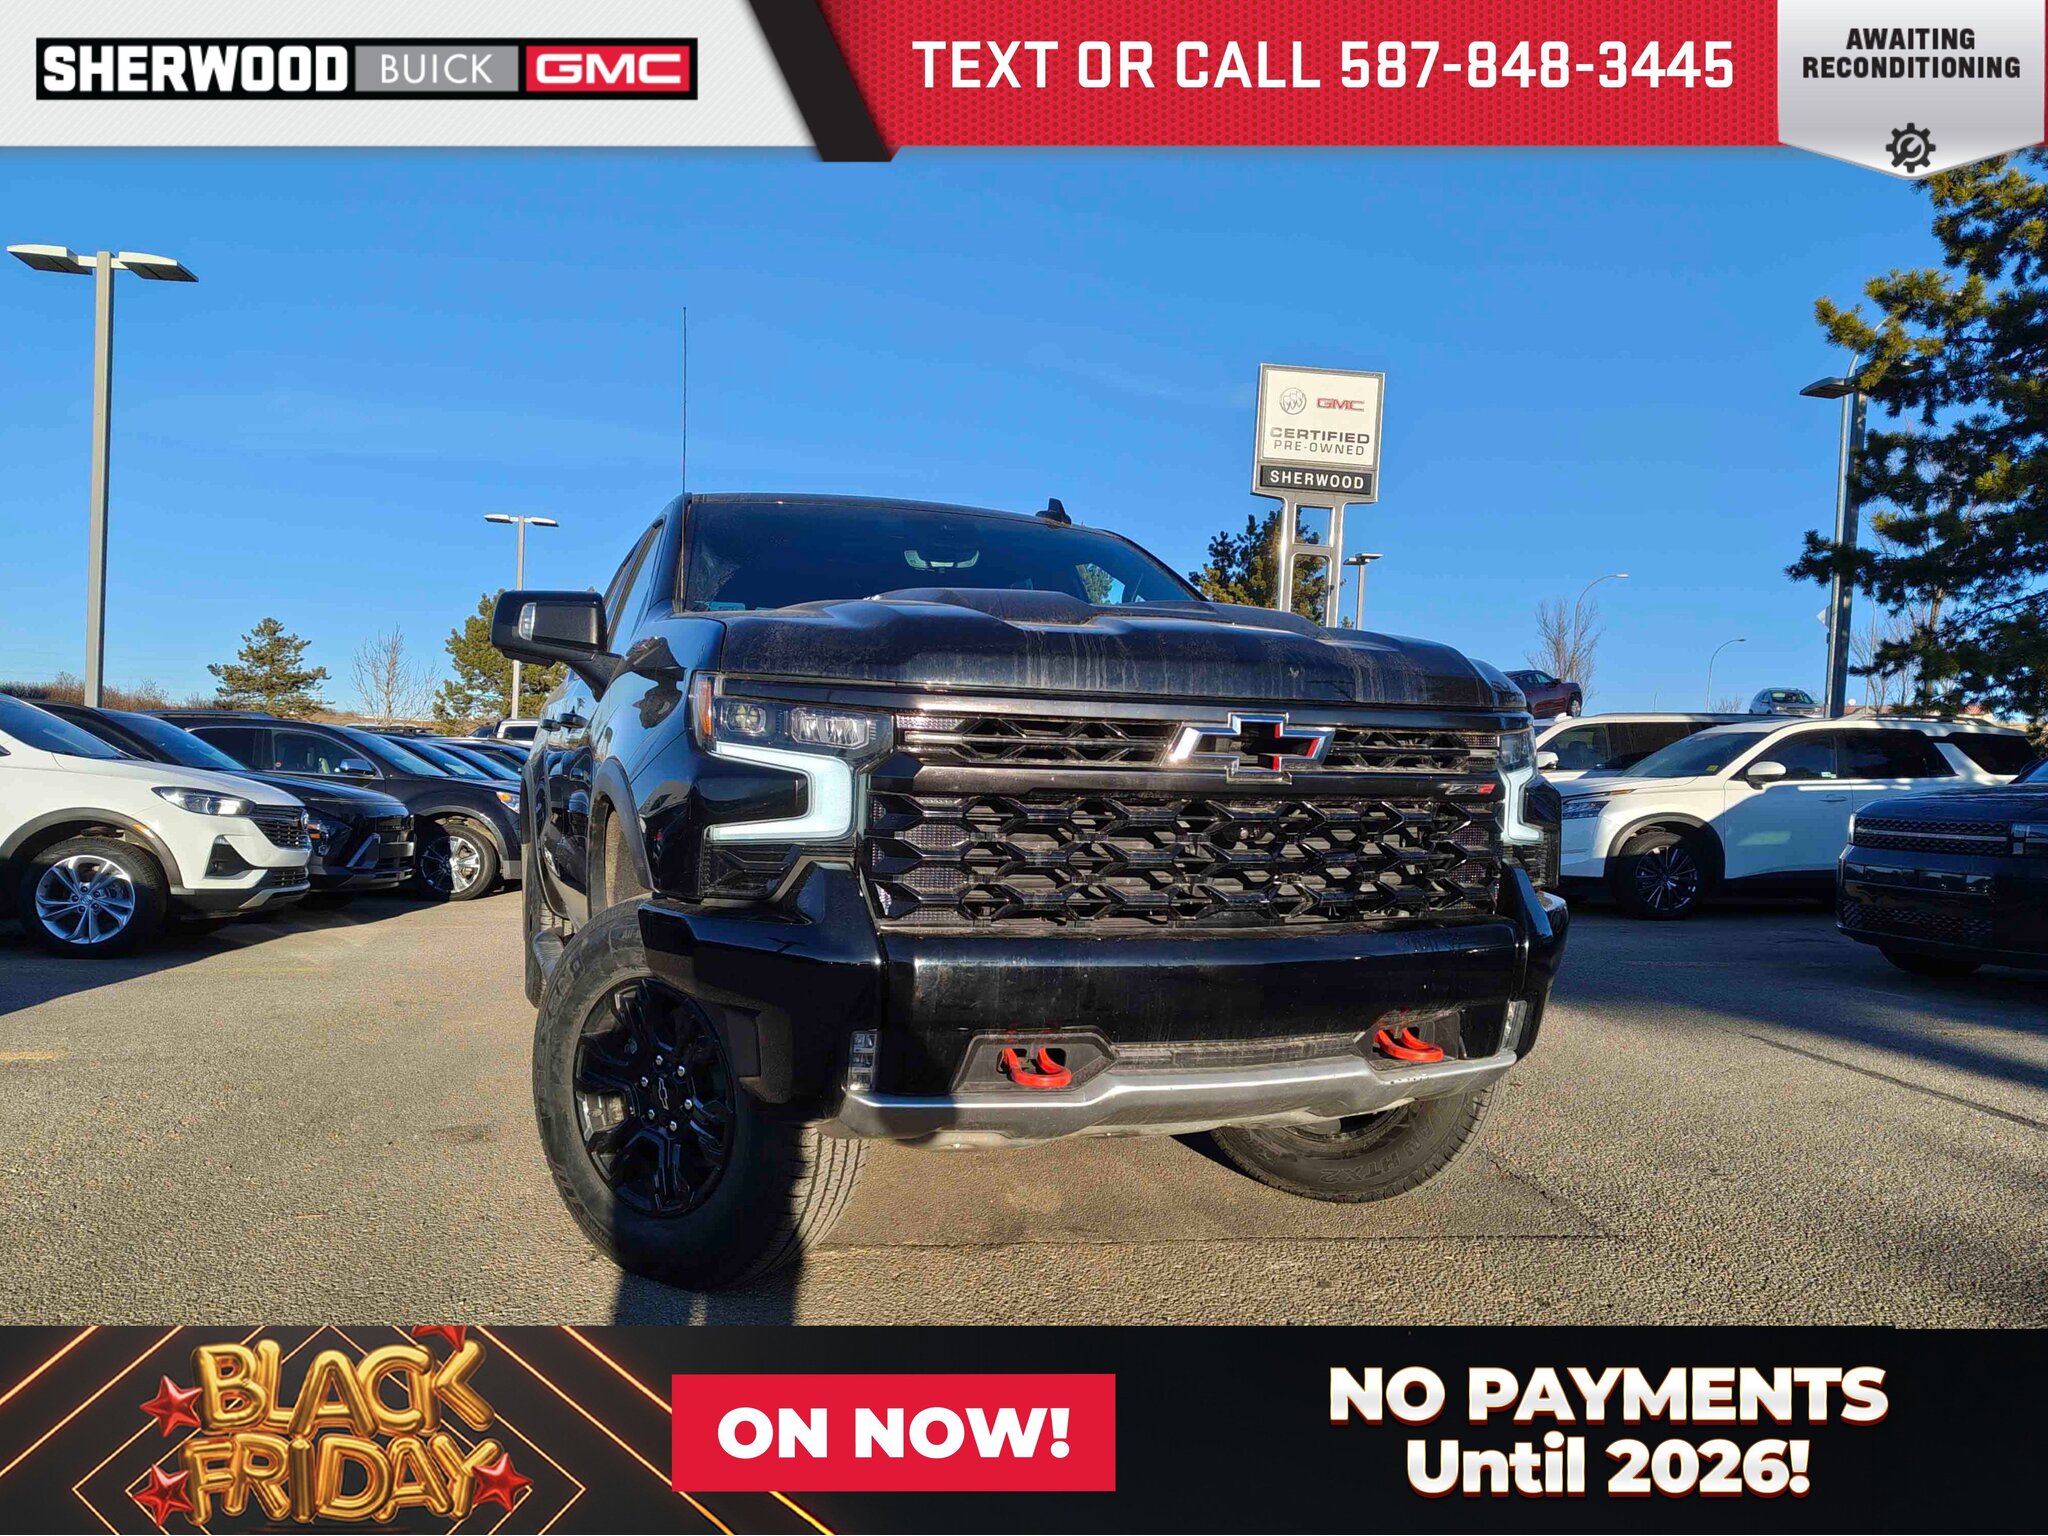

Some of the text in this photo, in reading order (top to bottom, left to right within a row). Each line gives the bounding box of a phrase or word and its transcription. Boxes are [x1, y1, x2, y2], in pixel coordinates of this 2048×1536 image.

[1317, 397, 1365, 411] GMC
[1270, 427, 1370, 444] CERTIFIED
[1273, 440, 1364, 456] PRE-OWNED
[1270, 470, 1364, 489] SHERWOOD
